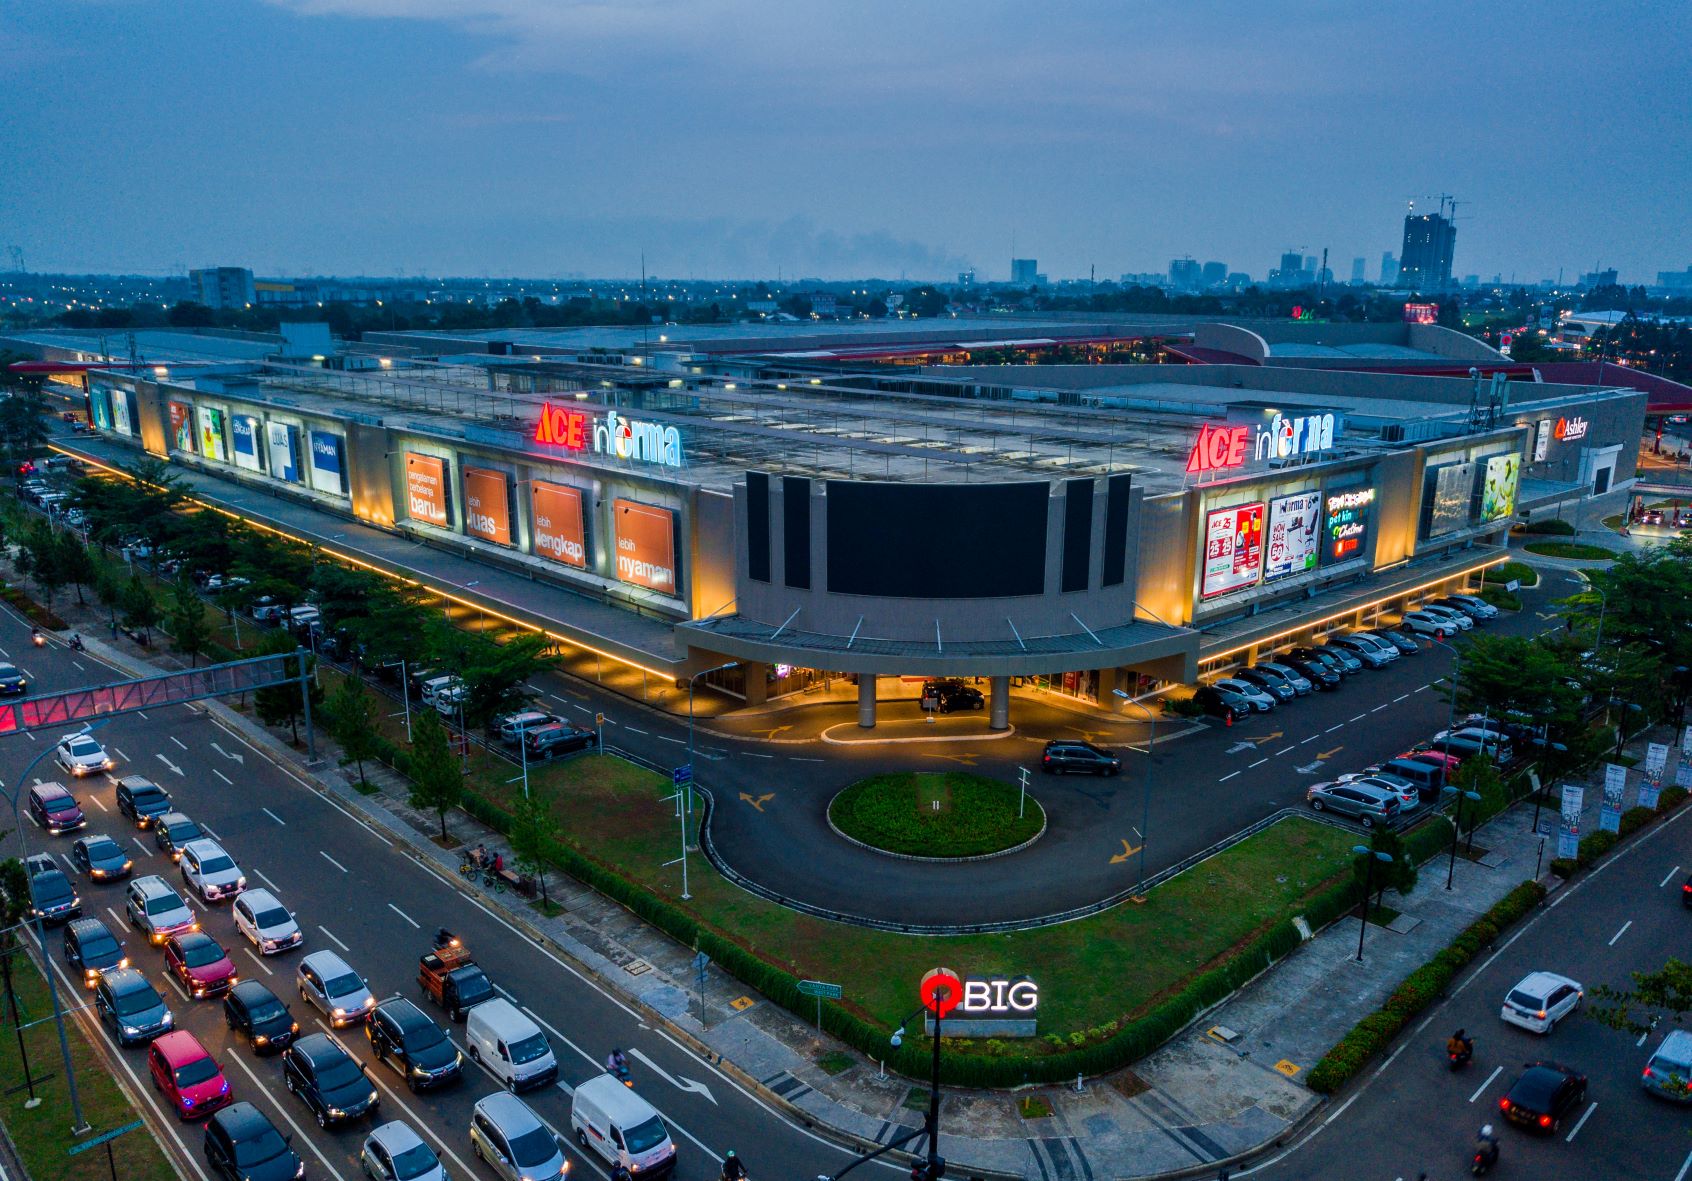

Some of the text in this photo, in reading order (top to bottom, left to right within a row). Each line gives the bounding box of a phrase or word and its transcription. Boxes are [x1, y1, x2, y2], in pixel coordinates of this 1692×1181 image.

[272, 431, 288, 448] LUAS
[536, 402, 681, 467] ACE informa
[1564, 417, 1588, 437] Ashley
[1186, 422, 1248, 472] ACE
[410, 492, 436, 517] baru
[469, 506, 496, 535] luas
[537, 514, 552, 530] lebih
[537, 529, 583, 562] lengkap
[618, 536, 636, 552] lebih
[1272, 533, 1285, 542] SALE
[618, 555, 673, 585] nyaman
